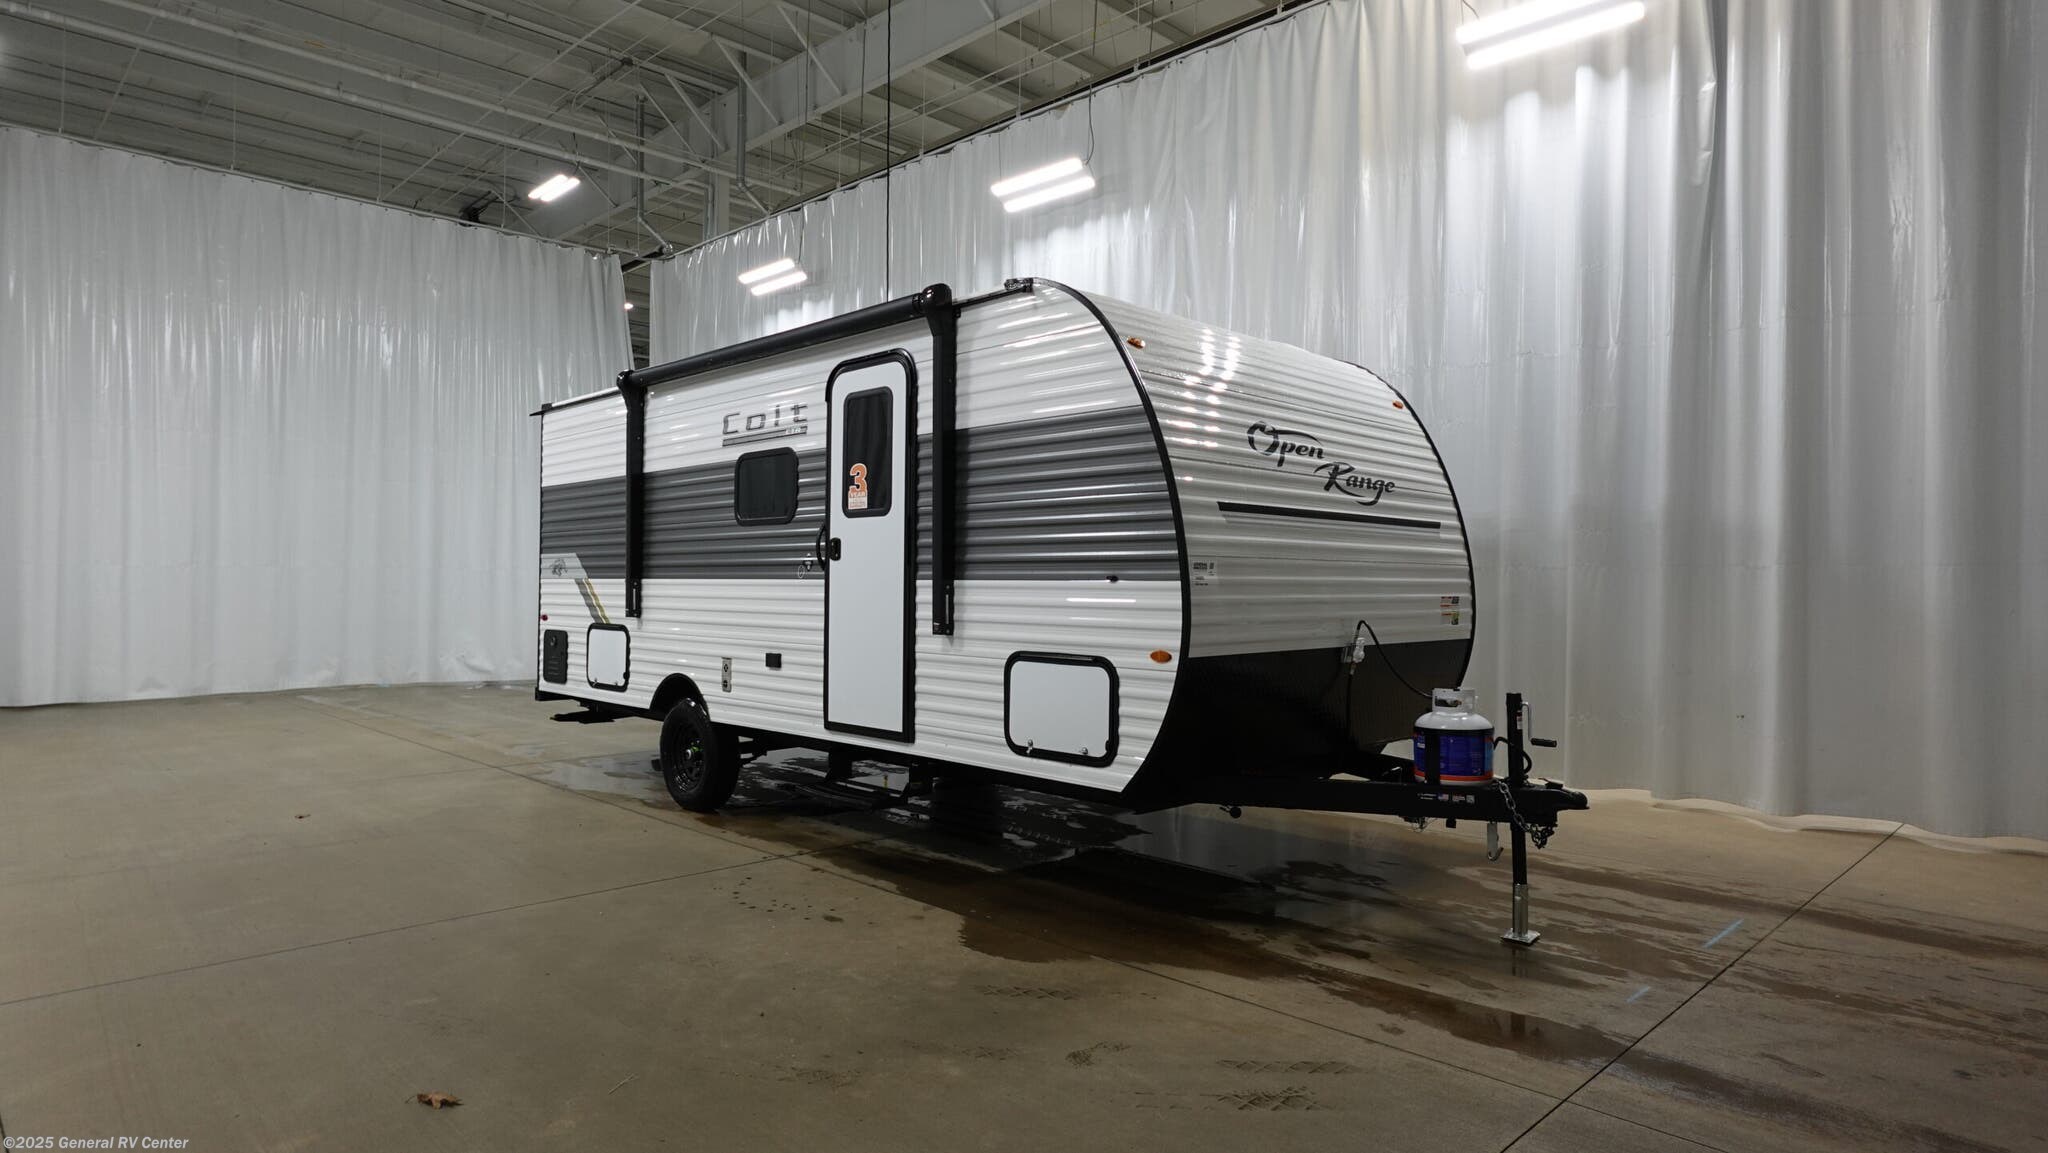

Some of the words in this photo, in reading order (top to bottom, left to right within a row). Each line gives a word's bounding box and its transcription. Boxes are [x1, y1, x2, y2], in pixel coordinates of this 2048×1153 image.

[723, 404, 808, 435] Colt
[1247, 421, 1324, 467] Open
[849, 463, 868, 493] 3
[1313, 462, 1396, 506] Range
